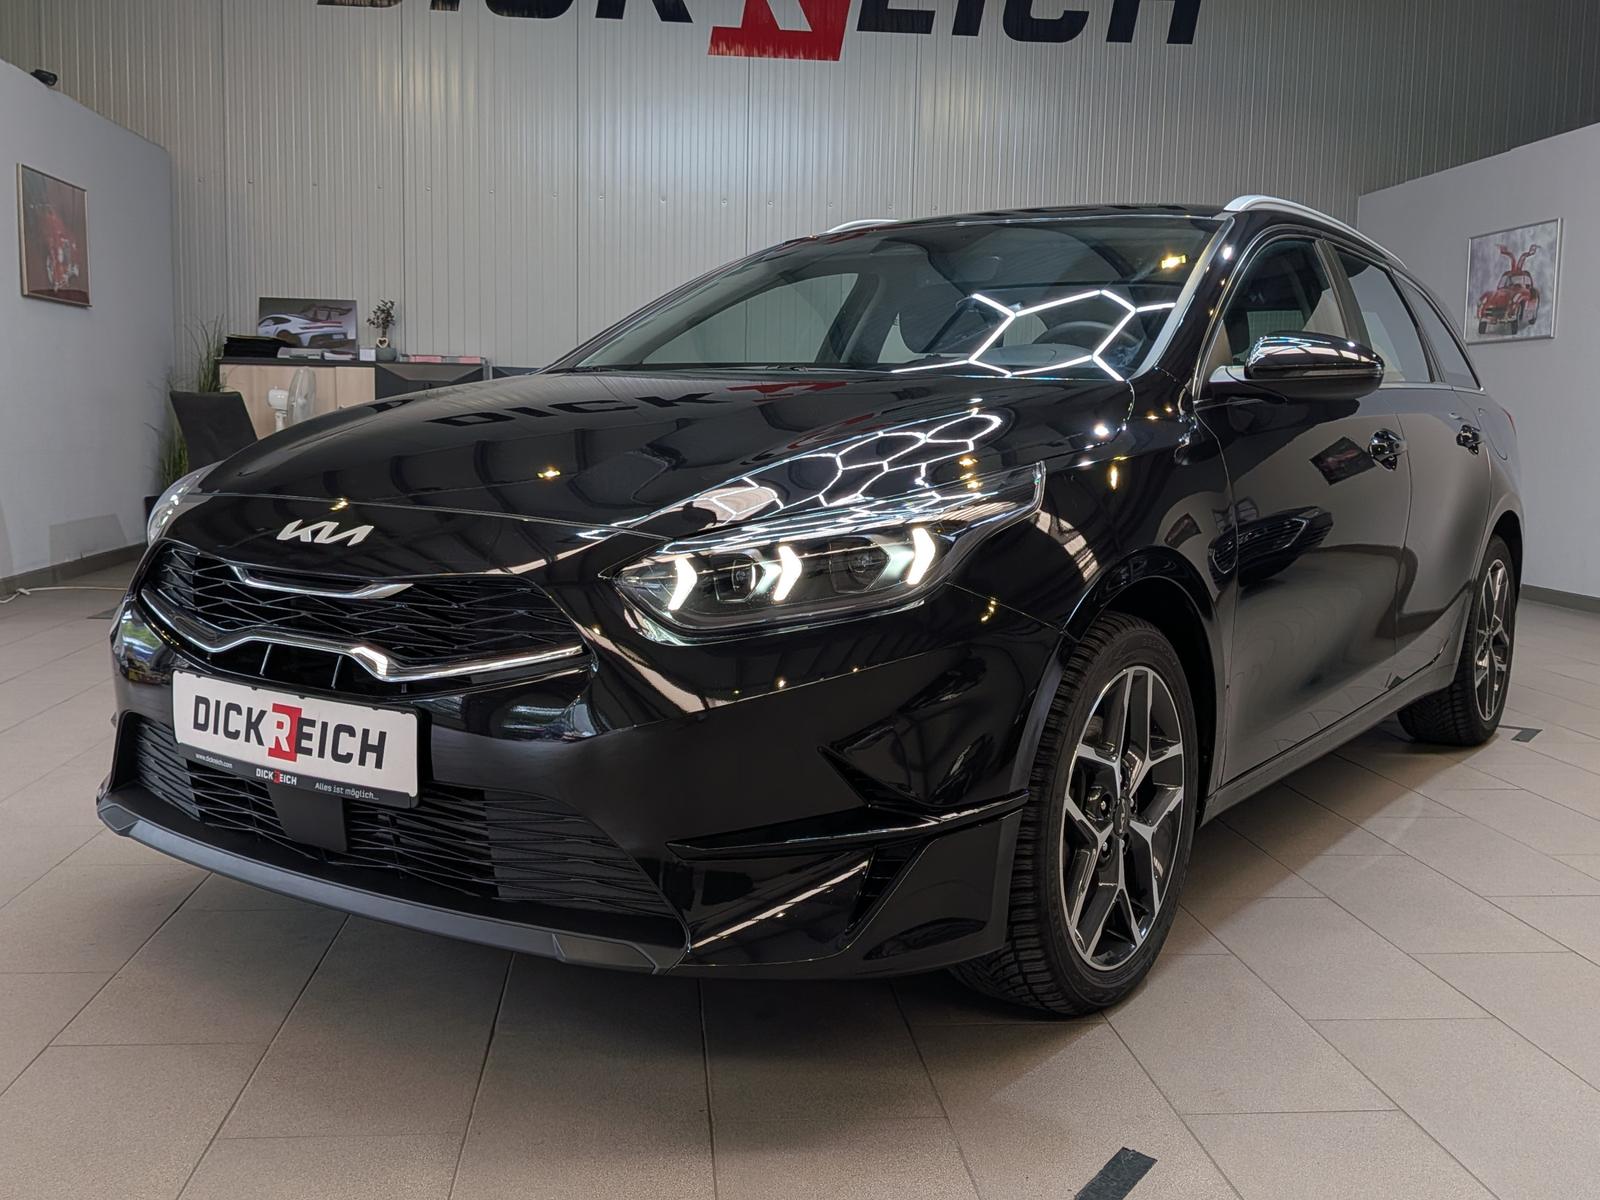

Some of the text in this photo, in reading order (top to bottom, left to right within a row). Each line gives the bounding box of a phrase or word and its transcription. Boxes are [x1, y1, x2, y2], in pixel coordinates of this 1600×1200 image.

[276, 519, 375, 547] KIA
[192, 695, 388, 770] DICKREICH
[314, 782, 332, 793] Alles
[332, 784, 345, 795] ist
